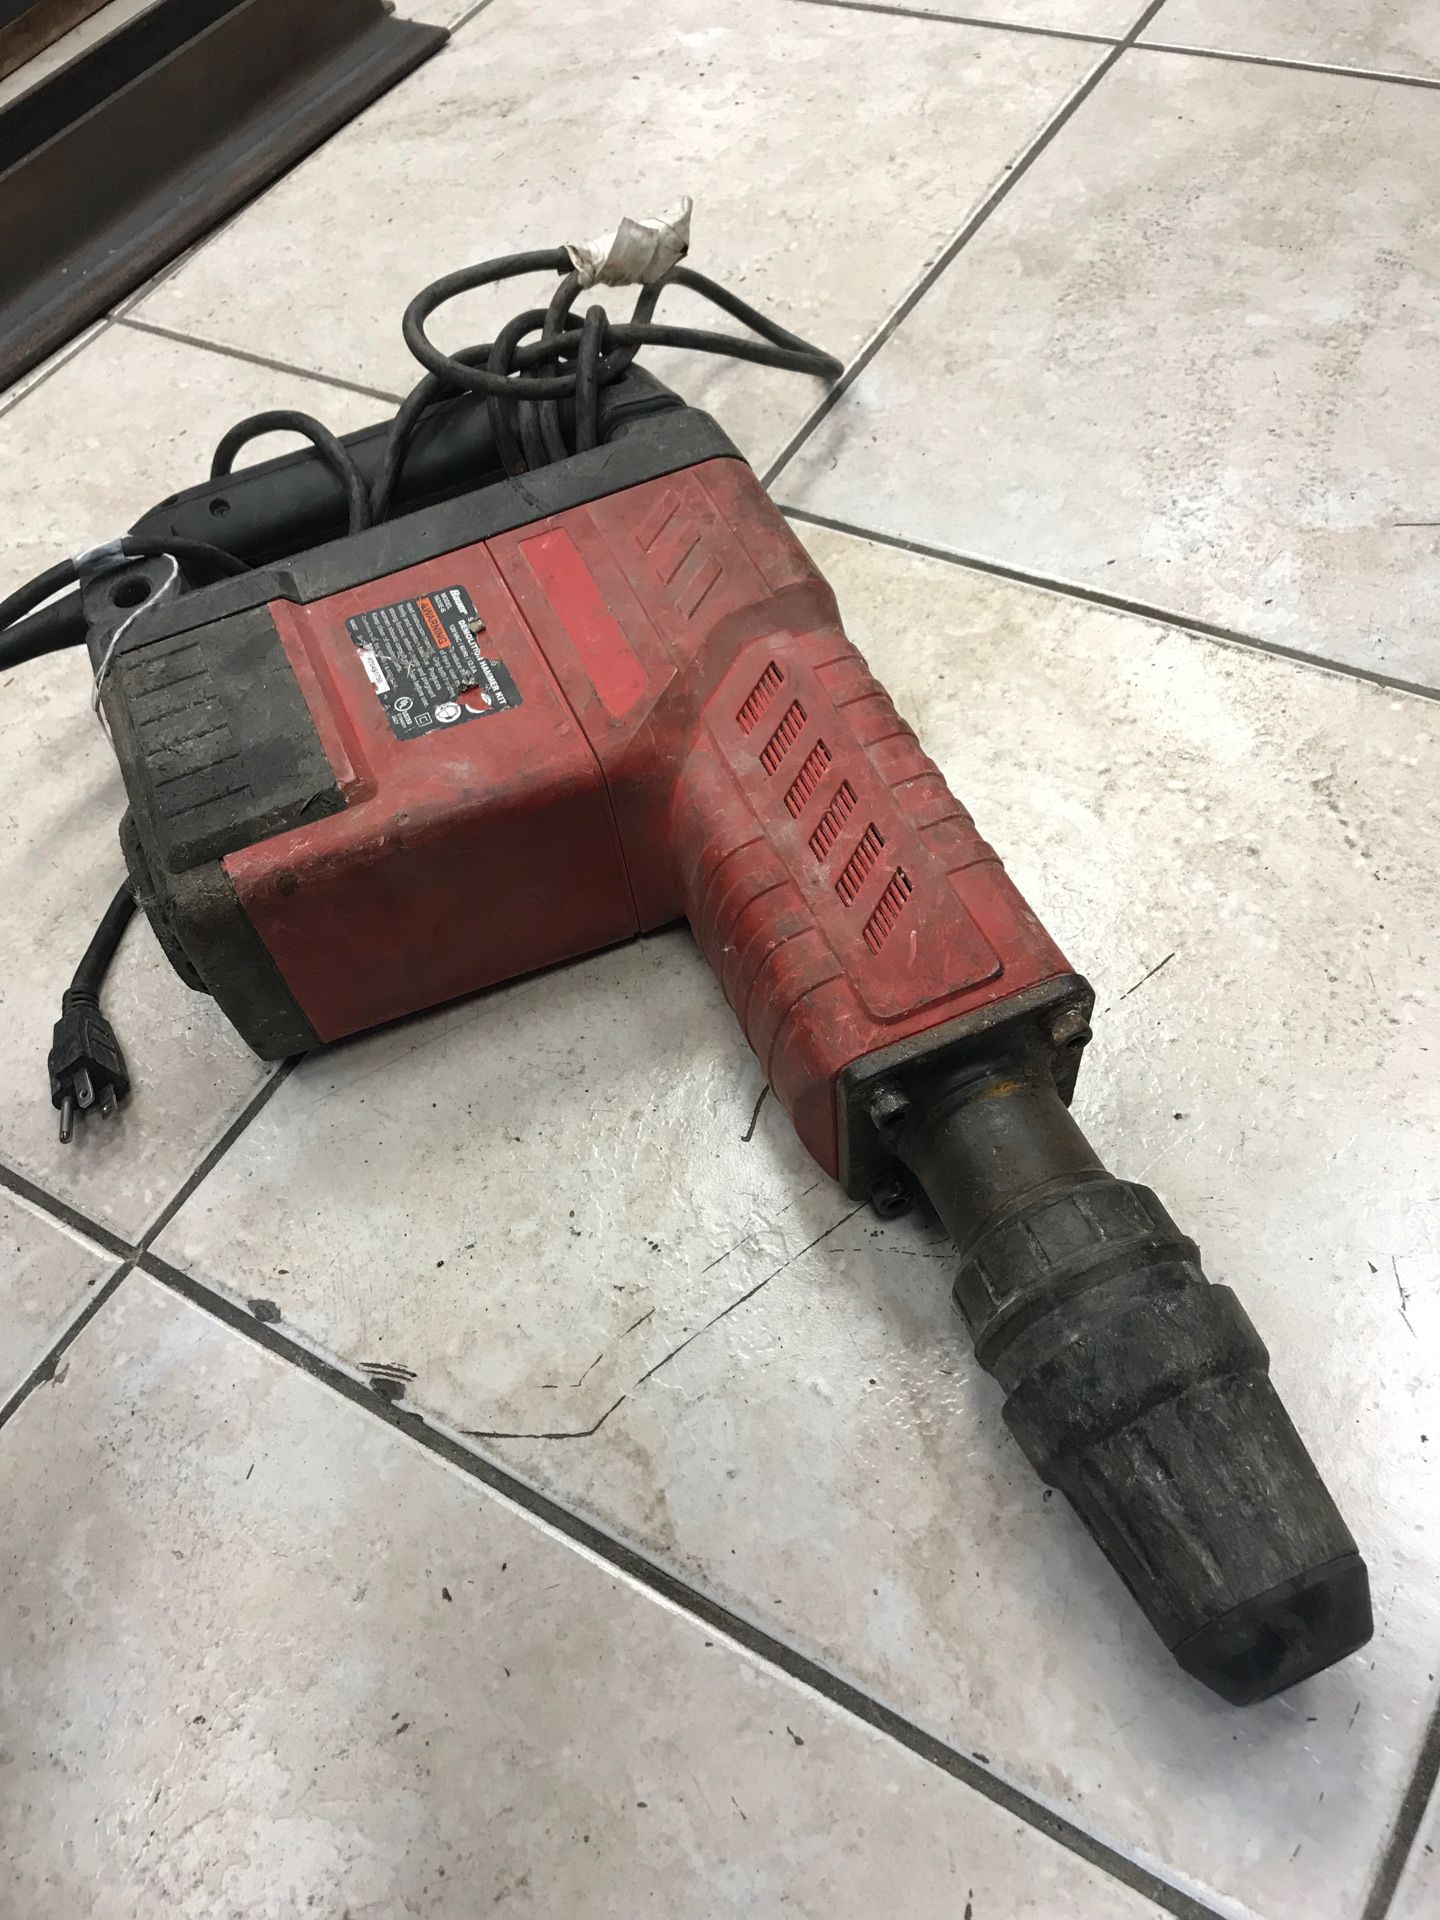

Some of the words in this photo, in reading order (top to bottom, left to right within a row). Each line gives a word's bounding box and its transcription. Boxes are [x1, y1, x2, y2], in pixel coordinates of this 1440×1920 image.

[441, 593, 453, 609] MODEL
[450, 589, 469, 615] Bauer
[424, 607, 447, 644] WARNING
[453, 632, 462, 643] VAC
[404, 617, 412, 627] and
[425, 667, 443, 691] Produces
[452, 653, 463, 670] reduce
[458, 620, 483, 660] DEMOLITION
[480, 661, 500, 691] HAMMER
[496, 692, 507, 704] KIT
[417, 667, 426, 677] and
[431, 656, 442, 668] Grip
[438, 667, 447, 678] both
[402, 711, 412, 725] LISTED
